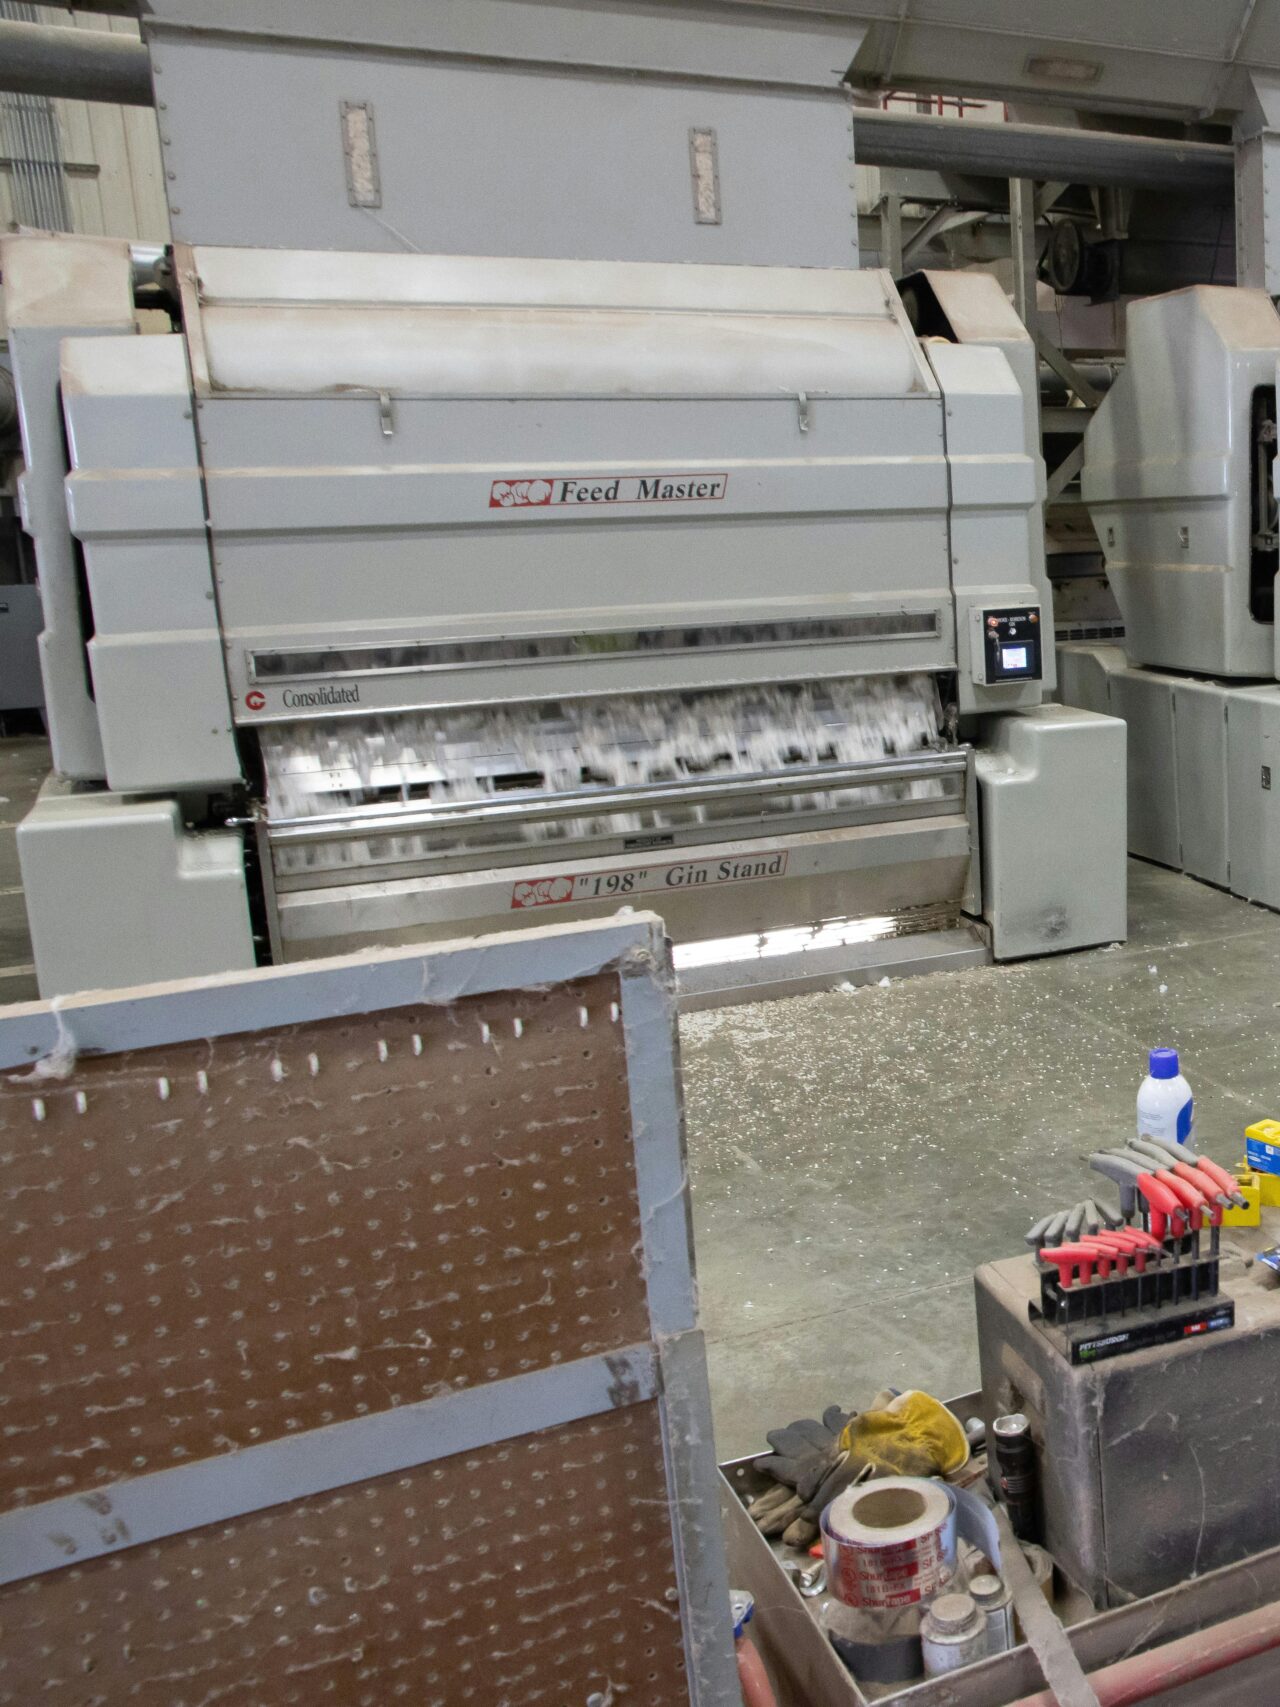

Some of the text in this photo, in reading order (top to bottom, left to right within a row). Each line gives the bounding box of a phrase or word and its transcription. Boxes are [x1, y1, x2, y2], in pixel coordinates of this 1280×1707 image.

[560, 478, 721, 502] Feed Master
[282, 684, 360, 708] Consolidated
[665, 866, 708, 887] Gin
[716, 855, 783, 880] Stand
